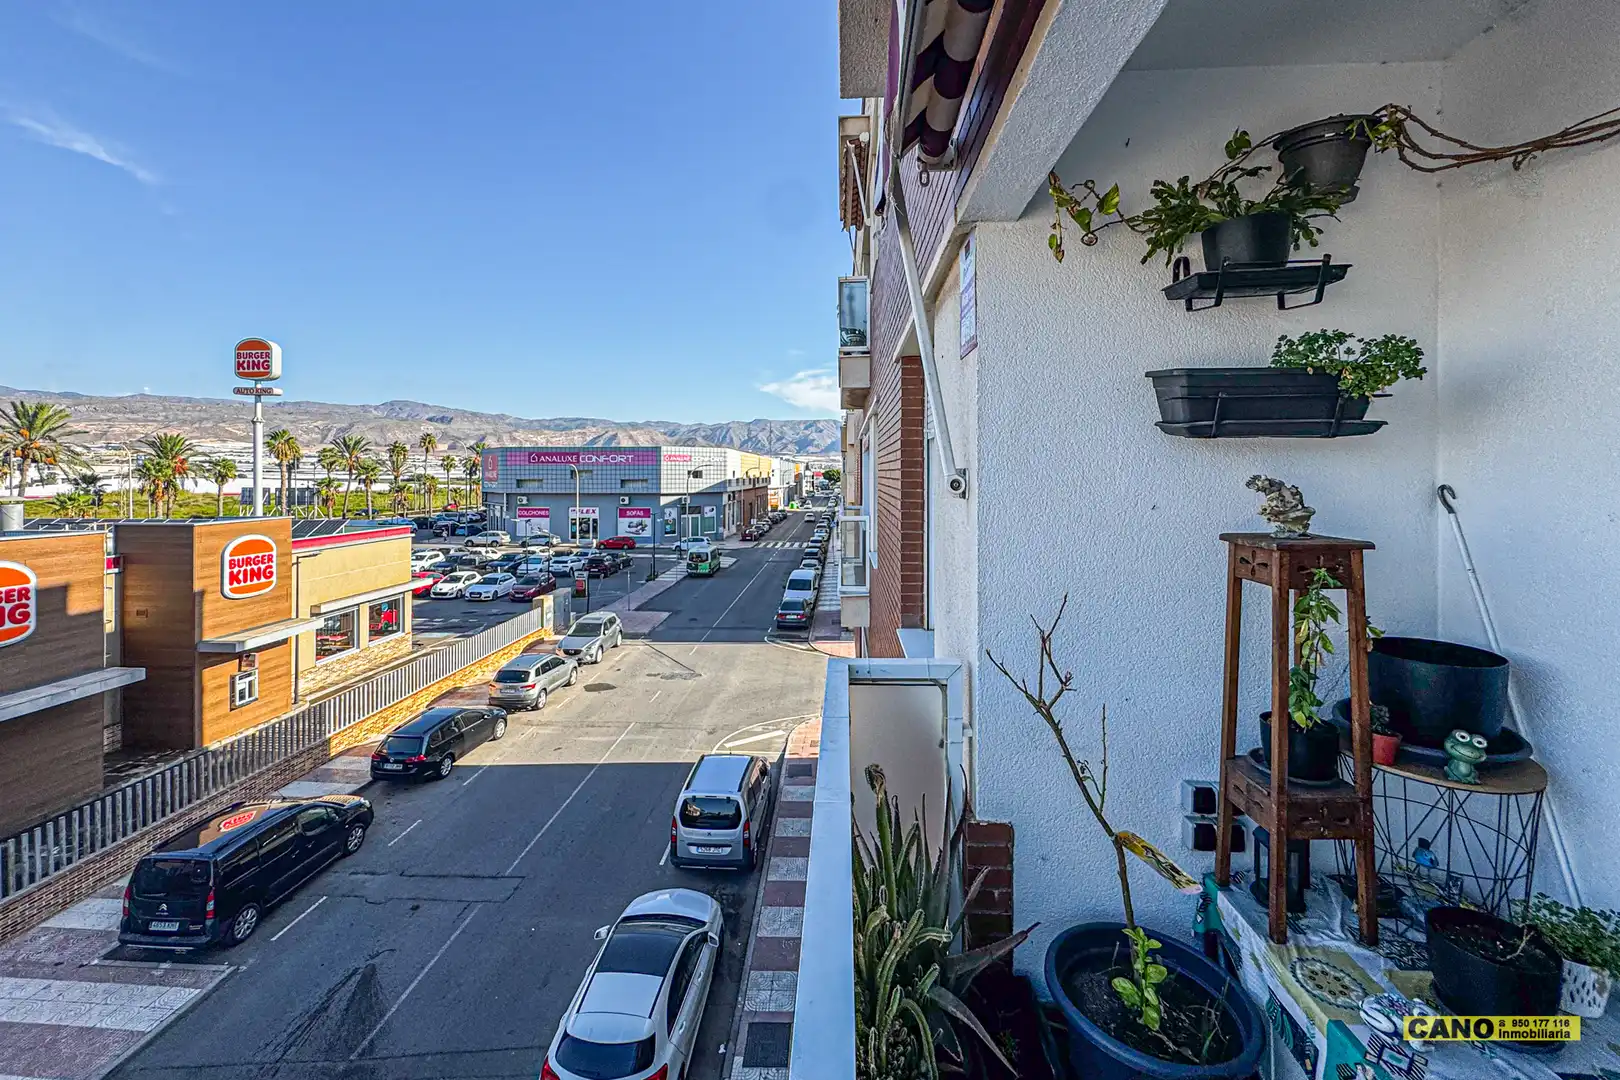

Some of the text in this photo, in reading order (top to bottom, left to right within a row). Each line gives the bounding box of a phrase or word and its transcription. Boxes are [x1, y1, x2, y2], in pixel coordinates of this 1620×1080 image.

[236, 351, 271, 360] BURGER
[236, 359, 271, 371] KING
[539, 454, 634, 463] ANALUXE CONFORT
[228, 553, 274, 570] BURGER
[228, 564, 274, 587] KING
[0, 586, 31, 604] ER
